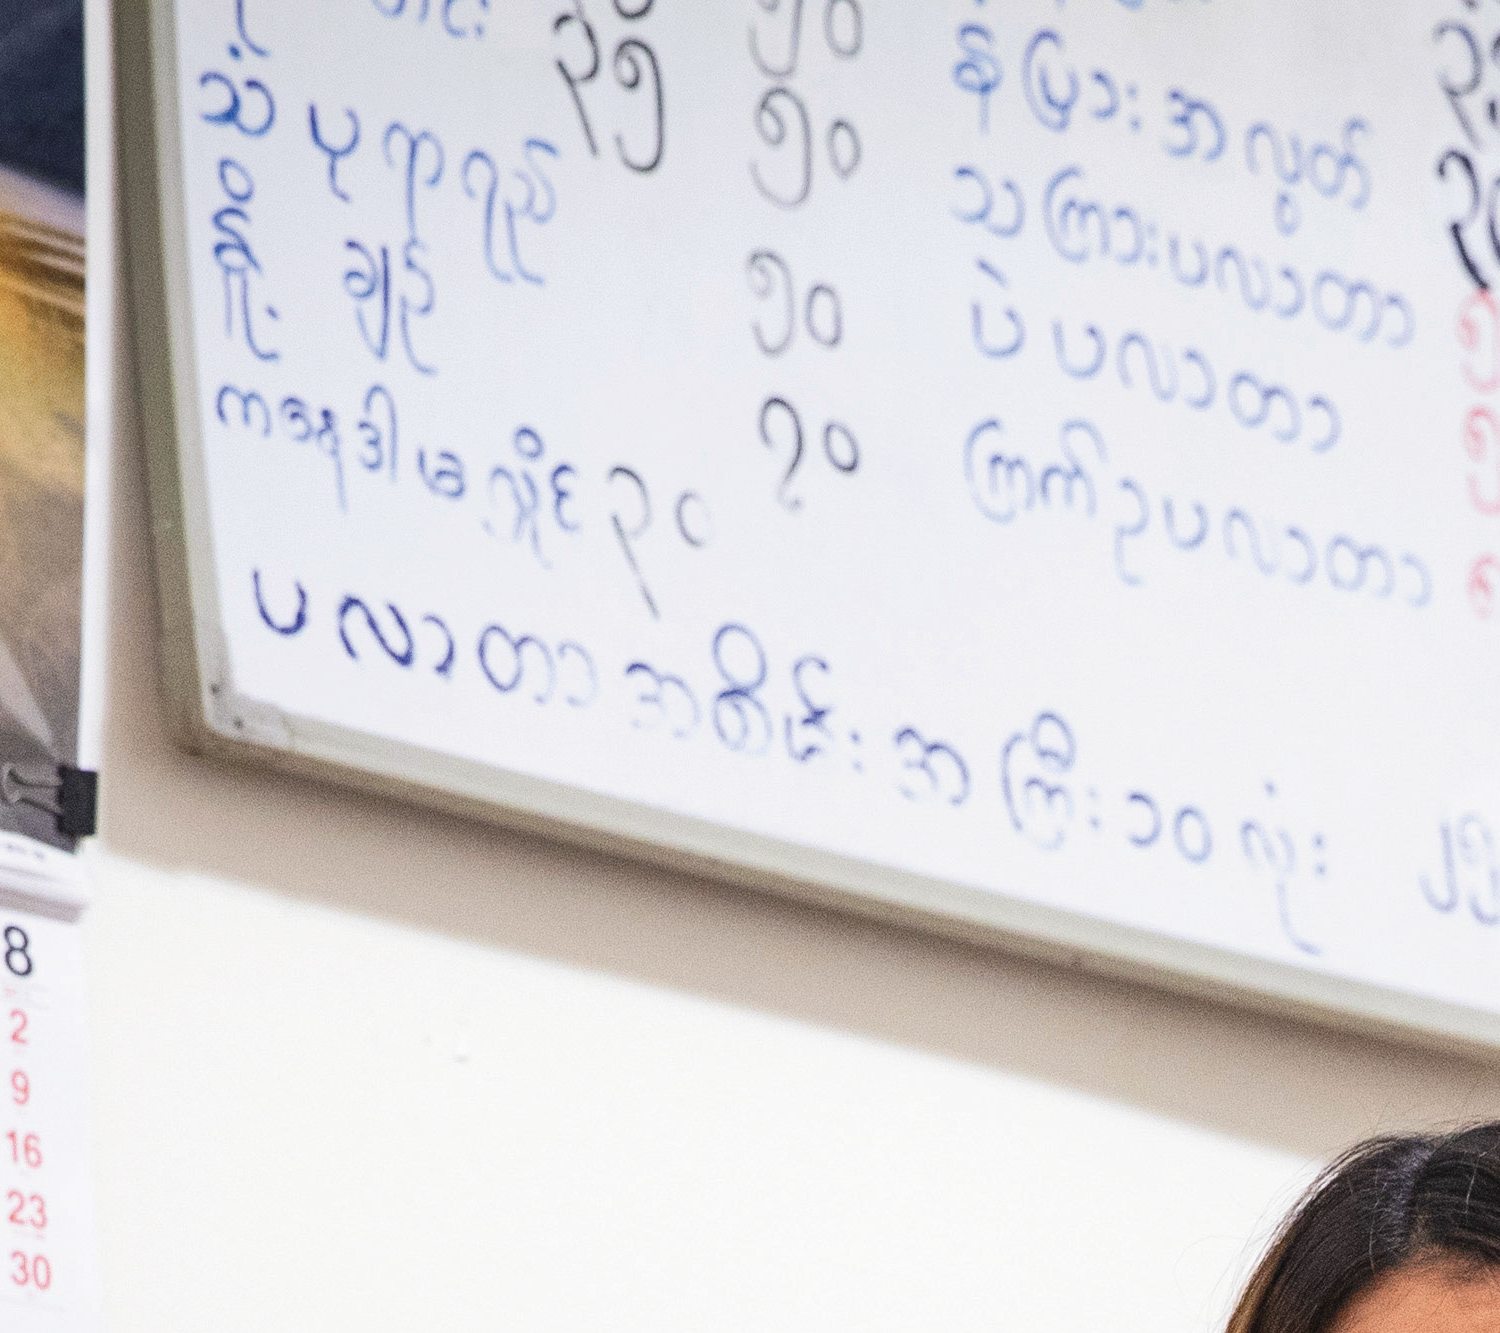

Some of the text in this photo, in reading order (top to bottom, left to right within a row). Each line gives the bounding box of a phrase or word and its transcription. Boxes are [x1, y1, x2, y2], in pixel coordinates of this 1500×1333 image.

[2, 923, 35, 979] 8
[8, 1007, 29, 1046] 2
[9, 1068, 32, 1107] 9
[5, 1129, 43, 1169] 16
[6, 1188, 48, 1231] 23
[10, 1249, 53, 1291] 30
